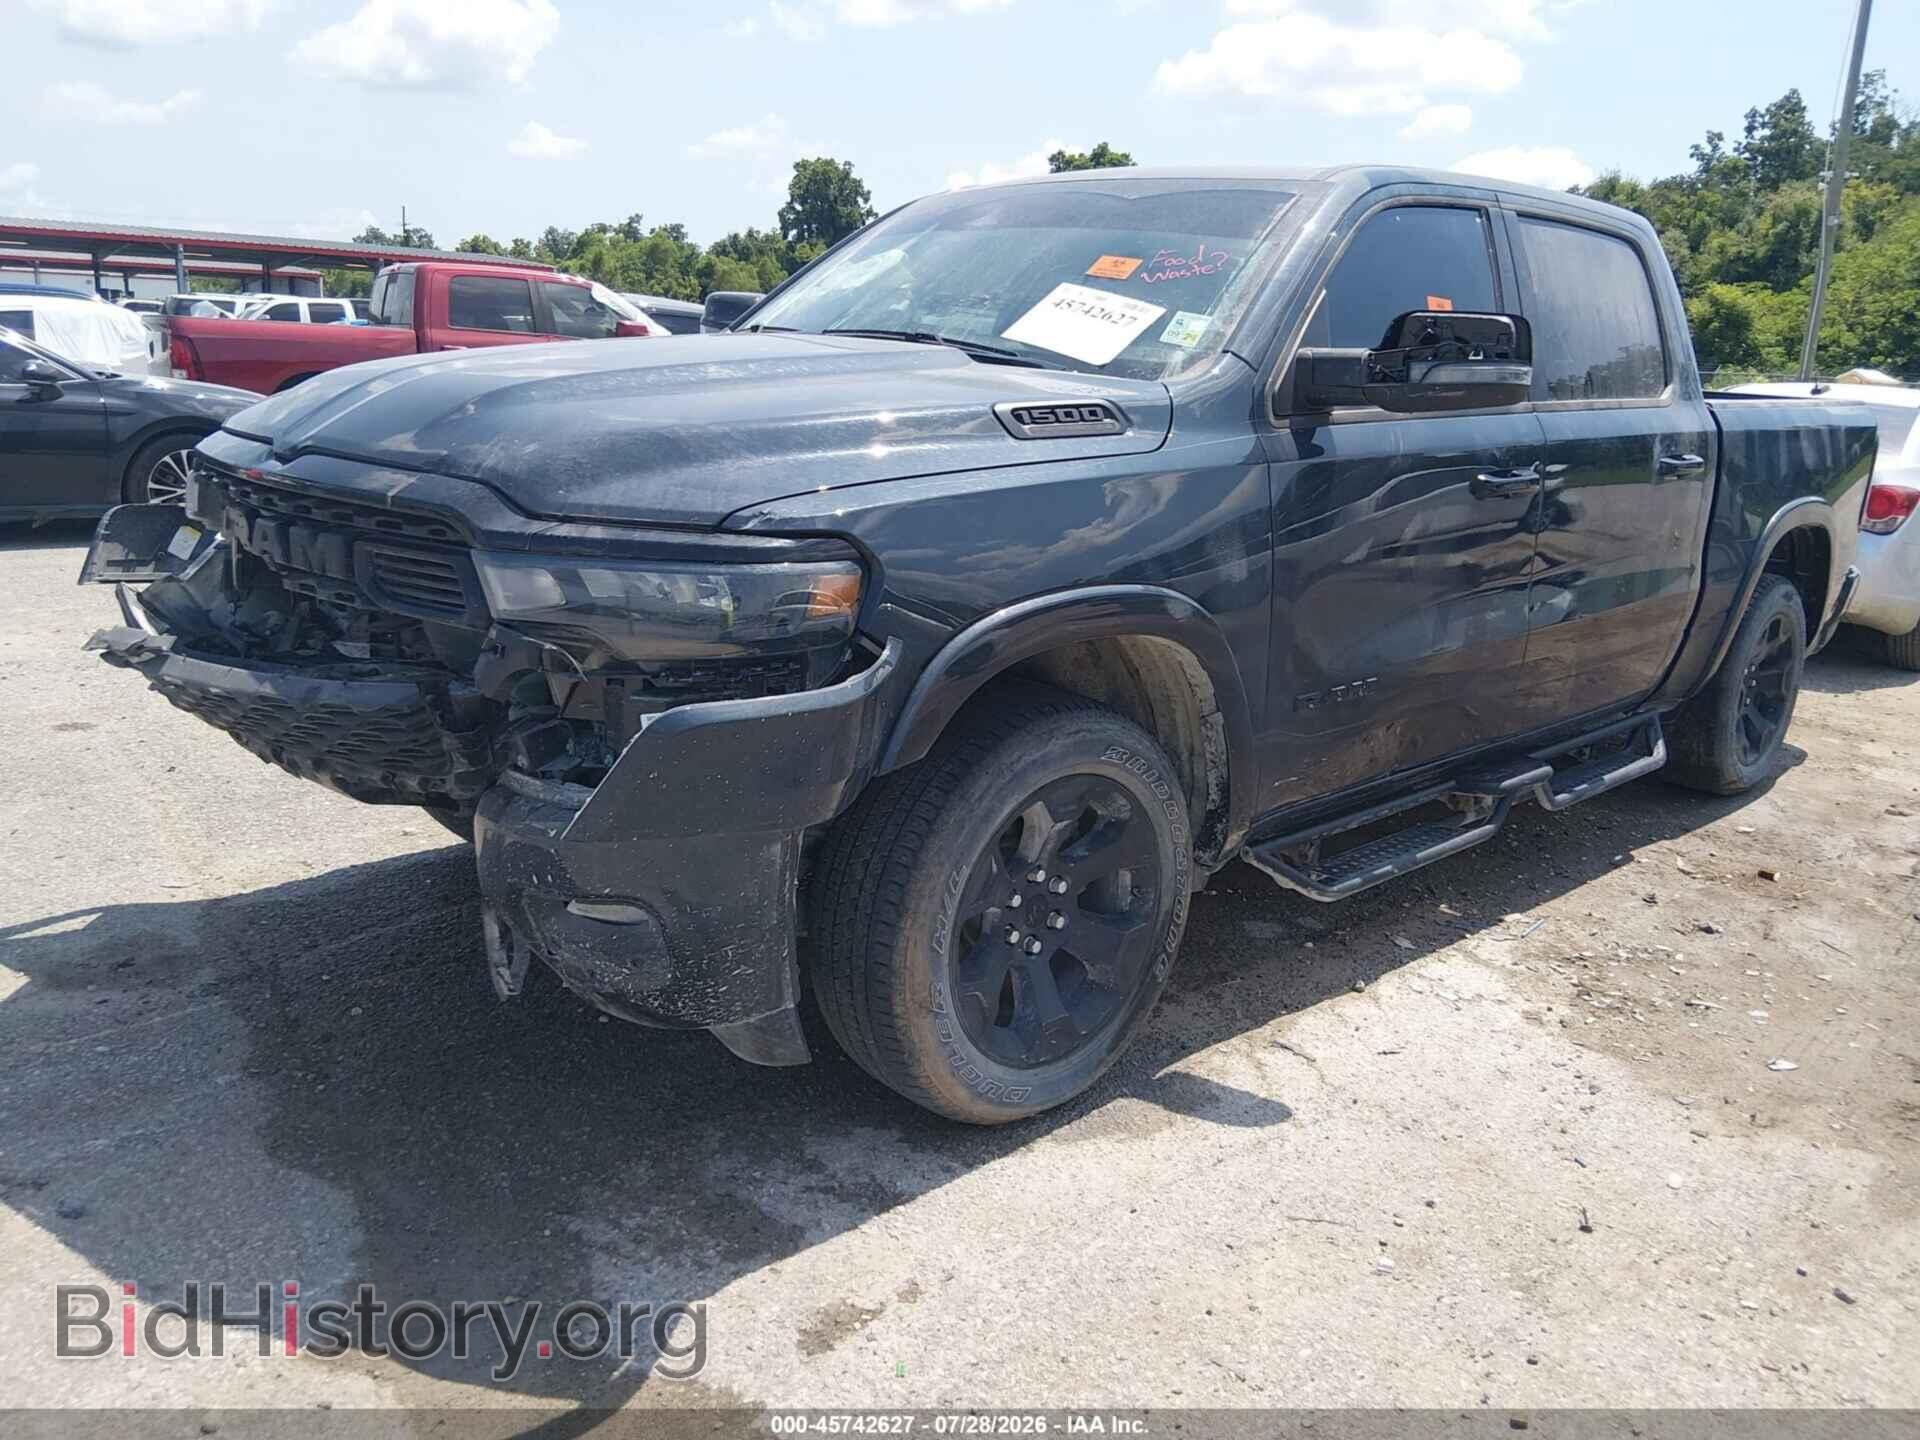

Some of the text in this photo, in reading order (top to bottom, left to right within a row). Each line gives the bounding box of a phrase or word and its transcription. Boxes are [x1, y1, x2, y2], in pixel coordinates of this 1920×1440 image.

[1052, 298, 1139, 328] 45742627
[1013, 406, 1106, 425] 1500
[1102, 745, 1187, 983] BRIDGESTONE
[928, 981, 1033, 1103] DUELER
